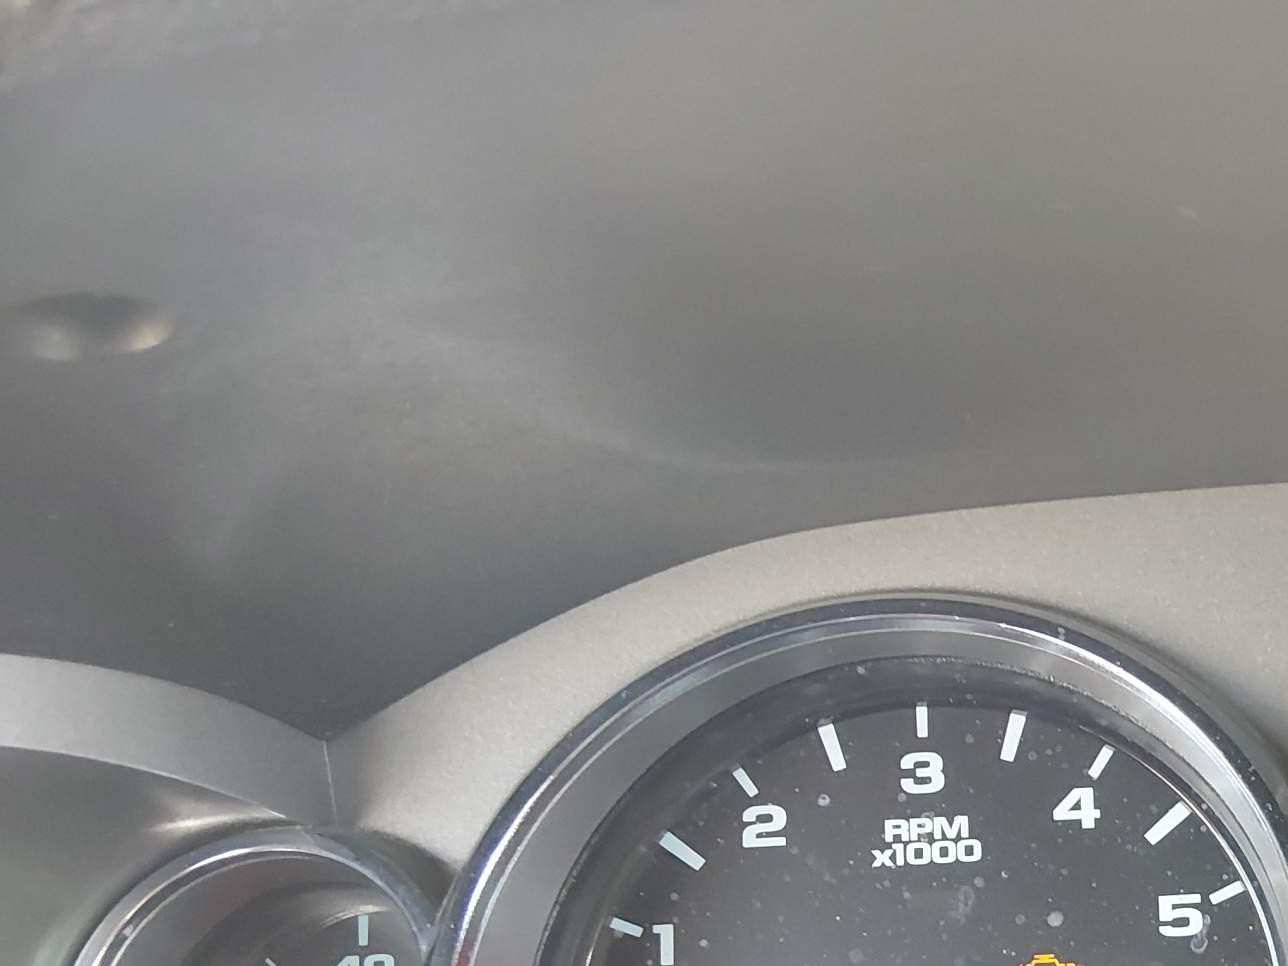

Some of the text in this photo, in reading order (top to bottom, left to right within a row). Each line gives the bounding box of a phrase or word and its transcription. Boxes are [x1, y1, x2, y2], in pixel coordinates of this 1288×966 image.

[900, 751, 945, 795] 3
[742, 803, 787, 848] 2
[884, 815, 969, 843] RPM
[1053, 786, 1101, 829] 4
[871, 838, 982, 868] x1000
[1158, 893, 1203, 937] 5
[652, 923, 675, 966] 1
